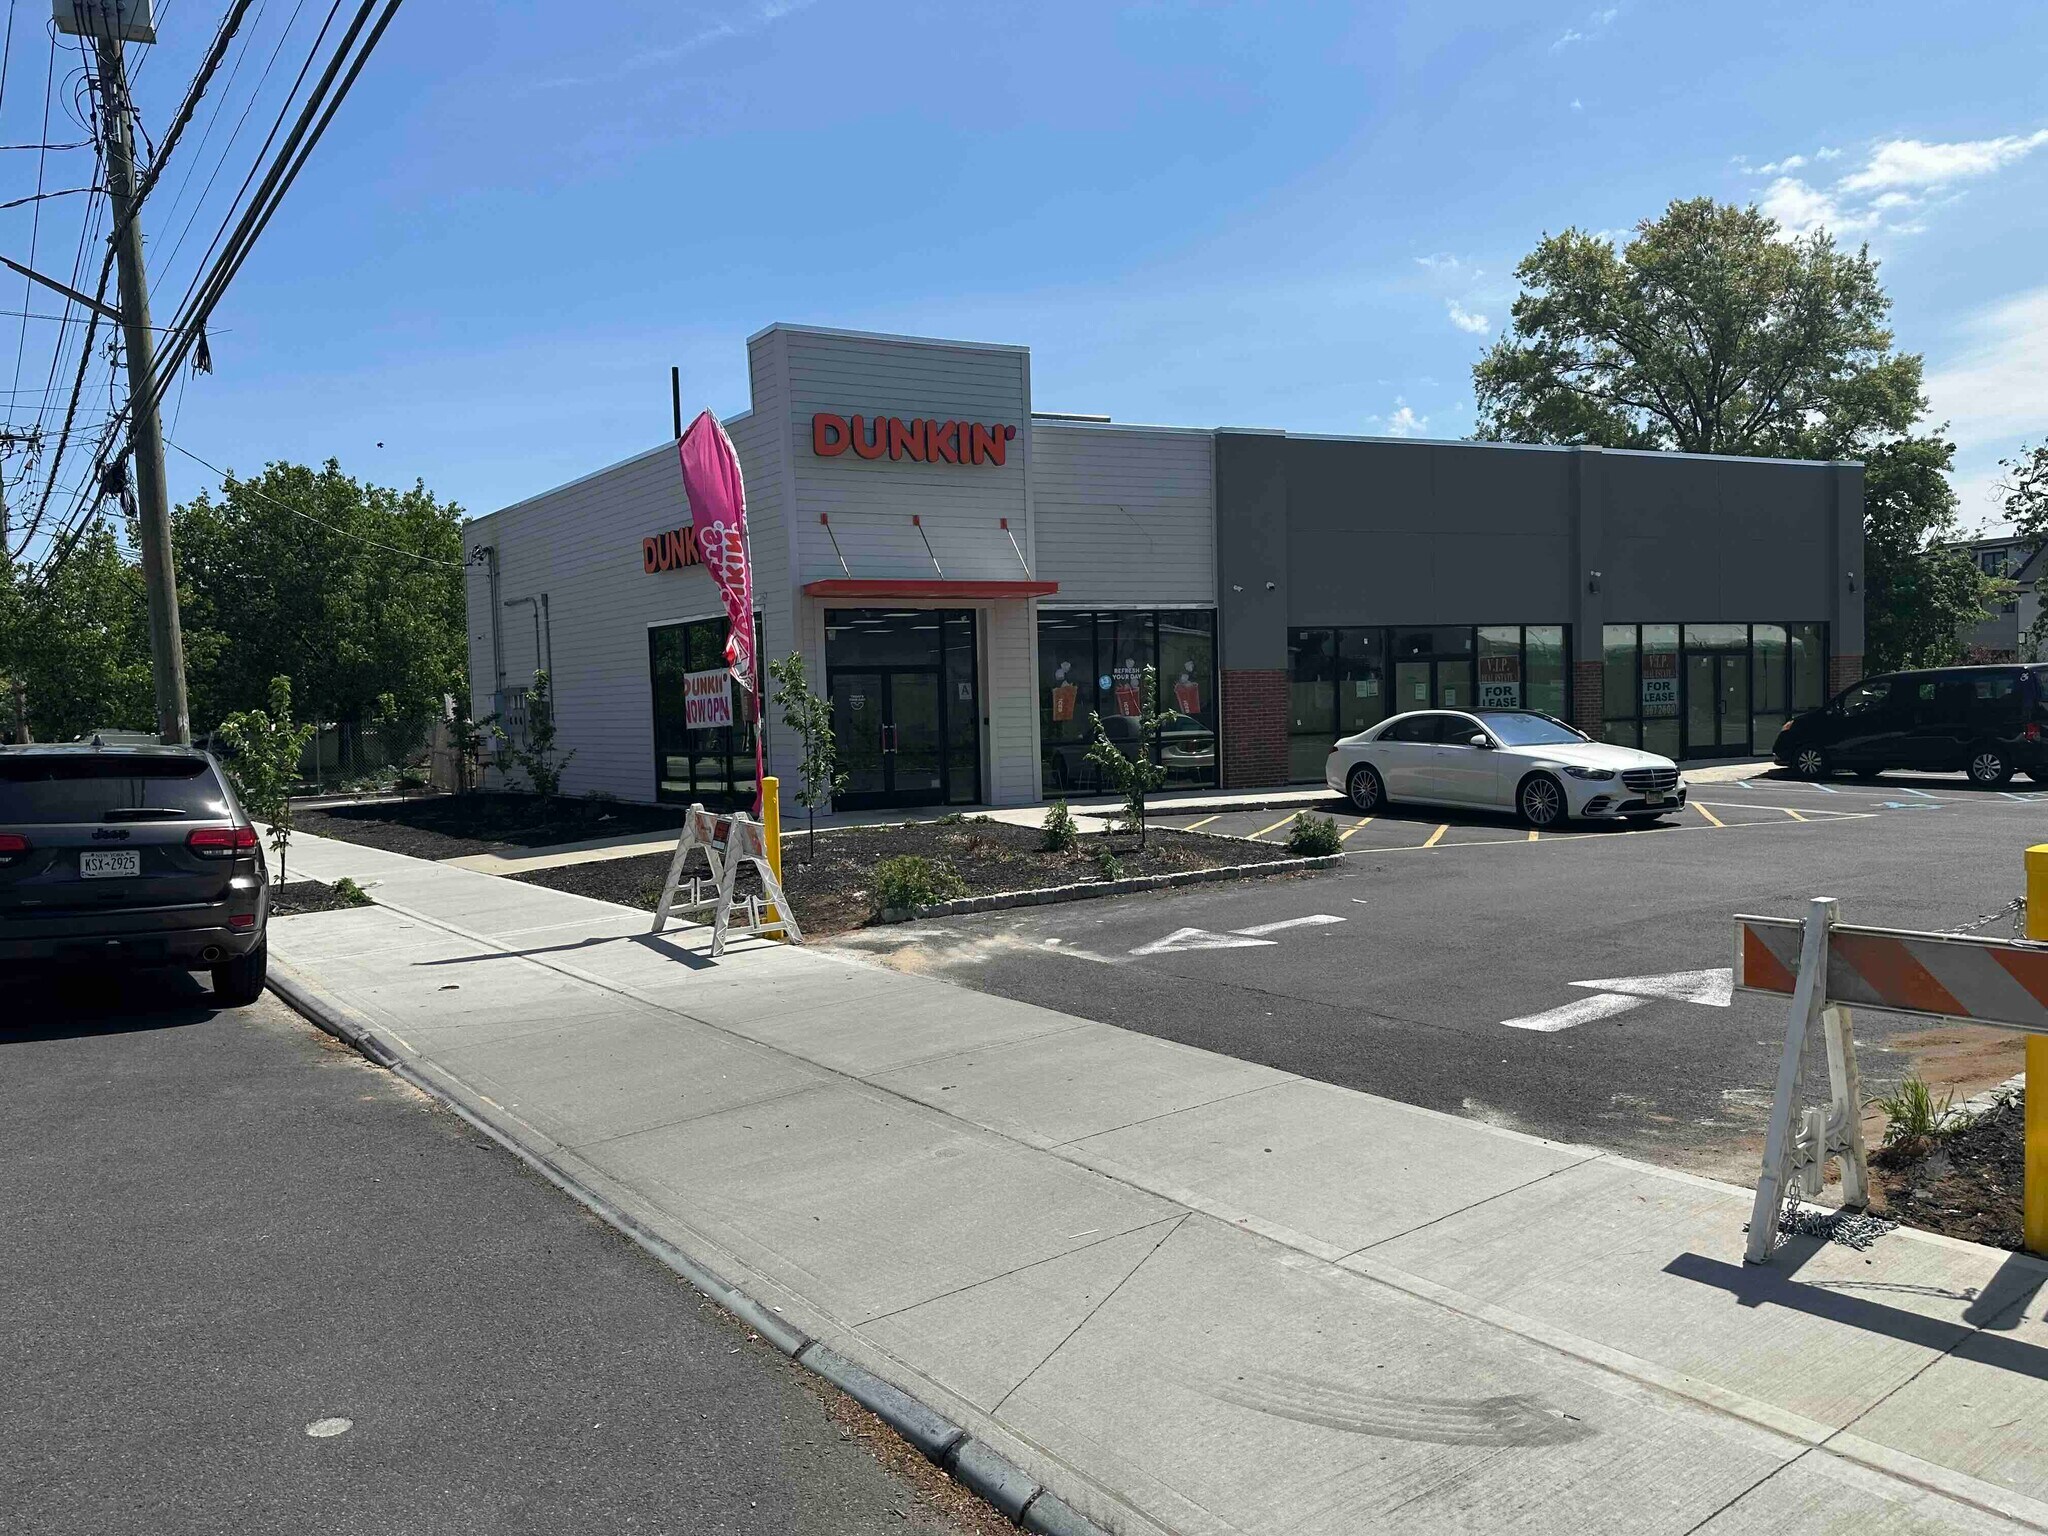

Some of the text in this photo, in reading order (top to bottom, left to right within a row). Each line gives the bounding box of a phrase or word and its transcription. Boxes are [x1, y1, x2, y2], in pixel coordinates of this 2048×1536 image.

[812, 413, 1016, 466] DUNKIN'
[643, 526, 701, 574] DUNK
[1485, 686, 1513, 697] FOR
[1647, 681, 1671, 691] FOR
[1482, 697, 1517, 708] LEASE
[1643, 692, 1675, 702] LEASE
[92, 828, 130, 840] Jeep
